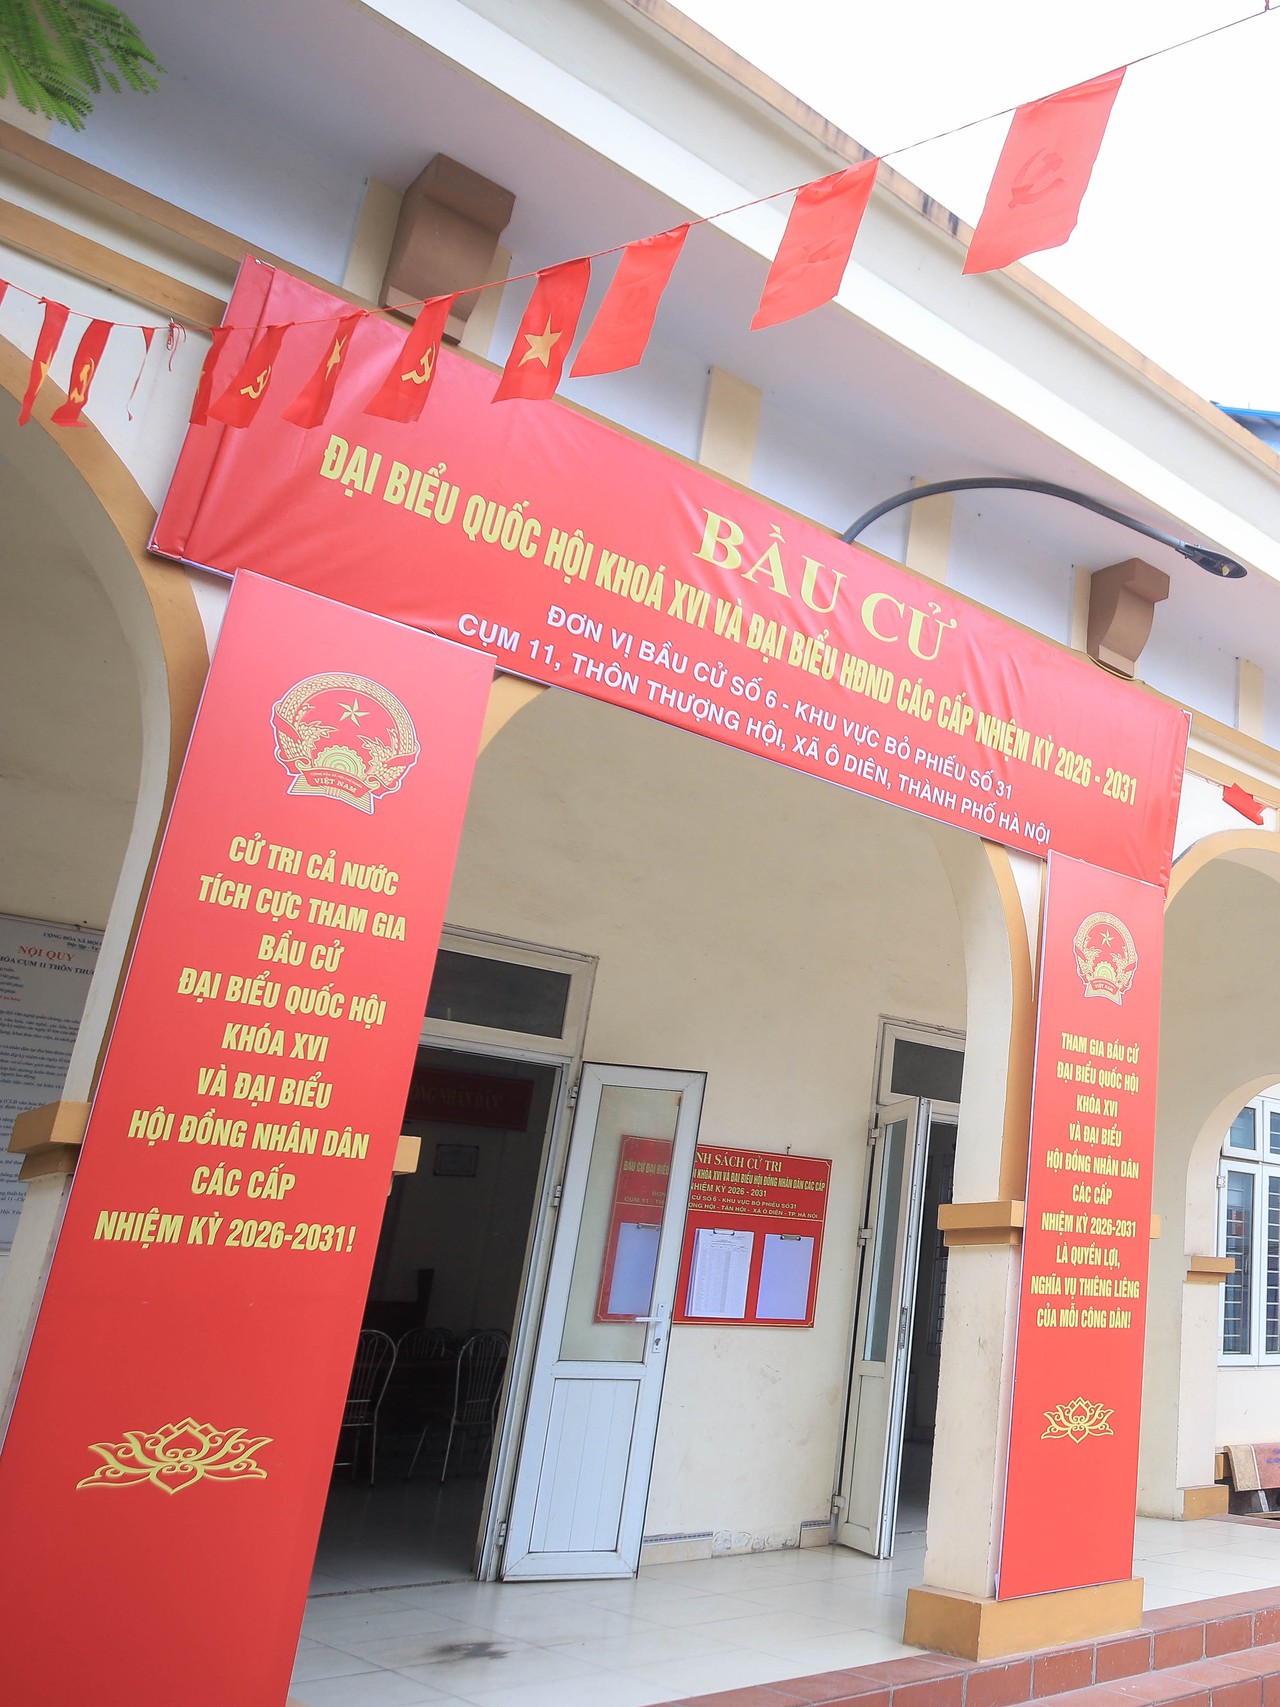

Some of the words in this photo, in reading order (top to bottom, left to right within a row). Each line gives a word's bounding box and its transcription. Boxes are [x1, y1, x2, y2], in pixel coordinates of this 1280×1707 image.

[692, 507, 848, 614] BẦU
[860, 592, 958, 661] CỬ
[319, 433, 382, 498] ĐẠI
[383, 460, 460, 525] BIỂU
[462, 494, 542, 559] QUỐC
[544, 527, 594, 585] HỘI
[594, 548, 666, 611] KHOÁ
[667, 579, 711, 629] XVI
[713, 597, 743, 643] VÀ
[746, 612, 787, 664] ĐẠI
[787, 629, 838, 681] BIỂU
[839, 652, 894, 705] HĐND
[896, 677, 935, 721] CÁC
[937, 692, 974, 737] CẤP
[975, 711, 1031, 762] NHIỆM
[1031, 734, 1055, 771] KỲ
[1054, 746, 1092, 788] 2026
[1102, 767, 1137, 806] 2031
[547, 604, 603, 643] ĐƠN
[611, 627, 634, 658] VỊ
[638, 640, 688, 674] BẦU
[693, 661, 728, 688] CỬ
[729, 675, 763, 702] SỐ
[765, 690, 778, 708] 6
[794, 700, 838, 732] KHU
[841, 717, 881, 747] VỰC
[884, 735, 911, 760] BỎ
[914, 747, 967, 782] PHIẾU
[969, 769, 994, 792] SỐ
[995, 780, 1013, 800] 31
[458, 613, 521, 653] CỤM
[529, 638, 562, 672] 11,
[571, 652, 640, 696] THÔN
[647, 679, 741, 731] THƯỢNG
[745, 717, 787, 752] HỘI,
[792, 734, 820, 760] XÃ
[825, 743, 840, 766] Ô
[843, 753, 892, 790] DIÊN,
[898, 773, 957, 810] THÀNH
[960, 797, 997, 824] PHỐ
[998, 811, 1020, 834] HÀ
[1024, 820, 1051, 845] NỘI
[314, 776, 335, 785] VIỆT
[337, 780, 357, 793] NAM
[228, 831, 267, 866] CỬ
[266, 844, 302, 875] TRI
[305, 849, 336, 883] CẢ
[340, 861, 400, 896] NƯỚC
[198, 872, 253, 911] TÍCH
[255, 887, 303, 923] CỰC
[307, 898, 369, 934] THAM
[371, 912, 407, 942] GIA
[19, 945, 42, 957] NỘI
[46, 950, 75, 961] QUY
[49, 963, 73, 972] THÔN
[257, 929, 307, 966] BẦU
[313, 939, 346, 973] CỬ
[177, 967, 221, 1004] ĐẠI
[224, 970, 282, 1009] BIỂU
[284, 982, 346, 1019] QUỐC
[348, 994, 388, 1030] HỘI
[221, 1022, 285, 1057] KHÓA
[289, 1032, 330, 1063] XVI
[1061, 1031, 1087, 1054] THAM
[1089, 1039, 1105, 1057] GIA
[1106, 1038, 1125, 1062] BẦU
[1126, 1042, 1140, 1065] CỬ
[196, 1063, 228, 1097] VÀ
[232, 1071, 277, 1108] ĐẠI
[278, 1071, 334, 1110] BIỂU
[1056, 1060, 1073, 1084] ĐẠI
[1075, 1060, 1097, 1085] BIỂU
[1098, 1066, 1122, 1090] QUỐC
[1124, 1072, 1140, 1095] HỘI
[1076, 1093, 1101, 1115] KHÓA
[1103, 1099, 1118, 1118] XVI
[127, 1105, 175, 1147] HỘI
[177, 1107, 248, 1149] ĐỒNG
[251, 1120, 320, 1156] NHÂN
[321, 1126, 370, 1161] DÂN
[1069, 1120, 1081, 1142] VÀ
[1083, 1125, 1099, 1147] ĐẠI
[1101, 1123, 1122, 1148] BIỂU
[695, 1151, 712, 1164] NH
[714, 1151, 744, 1168] SÁCH
[746, 1155, 763, 1170] CỬ
[764, 1160, 782, 1173] TRI
[1046, 1148, 1063, 1172] HỘI
[1065, 1148, 1091, 1174] ĐỒNG
[1093, 1155, 1119, 1177] NHÂN
[1120, 1158, 1140, 1179] DÂN
[191, 1161, 243, 1197] CÁC
[246, 1162, 297, 1201] CẤP
[727, 1186, 745, 1195] 2026
[750, 1188, 767, 1197] 2031
[1072, 1182, 1092, 1204] CÁC
[1093, 1182, 1113, 1206] CẤP
[93, 1206, 184, 1249] NHIỆM
[186, 1210, 225, 1246] KỲ
[225, 1217, 357, 1253] 2026-2031!
[1041, 1210, 1074, 1236] NHIỆM
[1075, 1213, 1089, 1234] KỲ
[1090, 1218, 1136, 1238] 2026-2031
[1056, 1242, 1068, 1264] LÀ
[1070, 1242, 1101, 1266] QUYỀN
[1103, 1248, 1120, 1270] LỢI,
[1031, 1273, 1062, 1295] NGHĨA
[1064, 1277, 1077, 1299] VỤ
[1079, 1275, 1112, 1298] THIÊNG
[1114, 1276, 1140, 1298] LIÊNG
[1036, 1302, 1057, 1328] CỦA
[1059, 1303, 1079, 1328] MỖI
[1081, 1306, 1107, 1328] CÔNG
[1109, 1307, 1131, 1329] DÂN!
